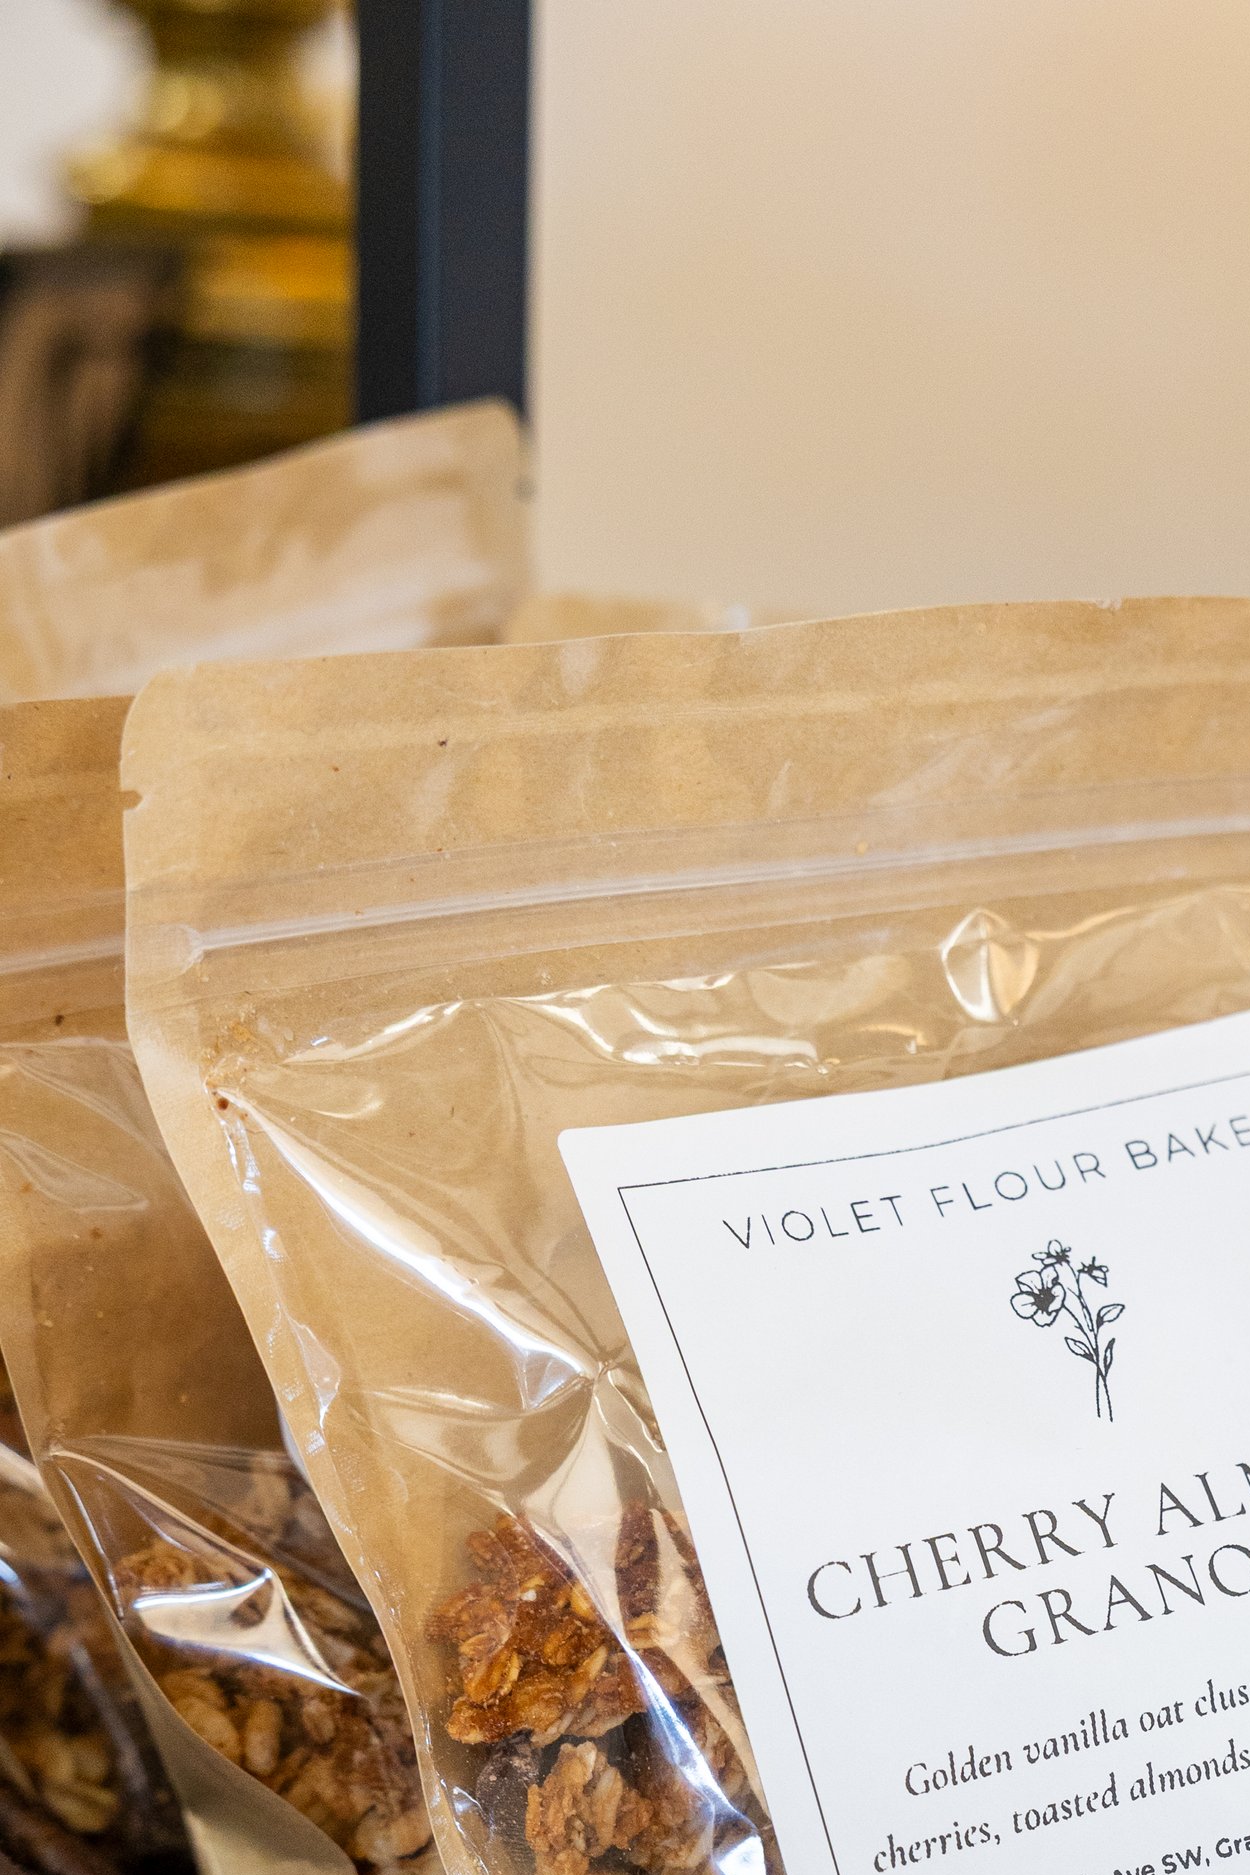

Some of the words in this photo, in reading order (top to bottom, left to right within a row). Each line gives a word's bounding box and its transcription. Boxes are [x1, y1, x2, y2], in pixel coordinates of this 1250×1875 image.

[721, 1194, 904, 1250] VIOLET
[929, 1151, 1107, 1219] FLOUR
[806, 1491, 1119, 1620] CHERRY
[904, 1744, 1013, 1797] Golden
[1022, 1708, 1130, 1765] vanilla
[1138, 1700, 1185, 1733] oat
[872, 1821, 1002, 1874] cherries,
[1012, 1770, 1120, 1835] toasted
[1160, 1845, 1211, 1875] SW,
